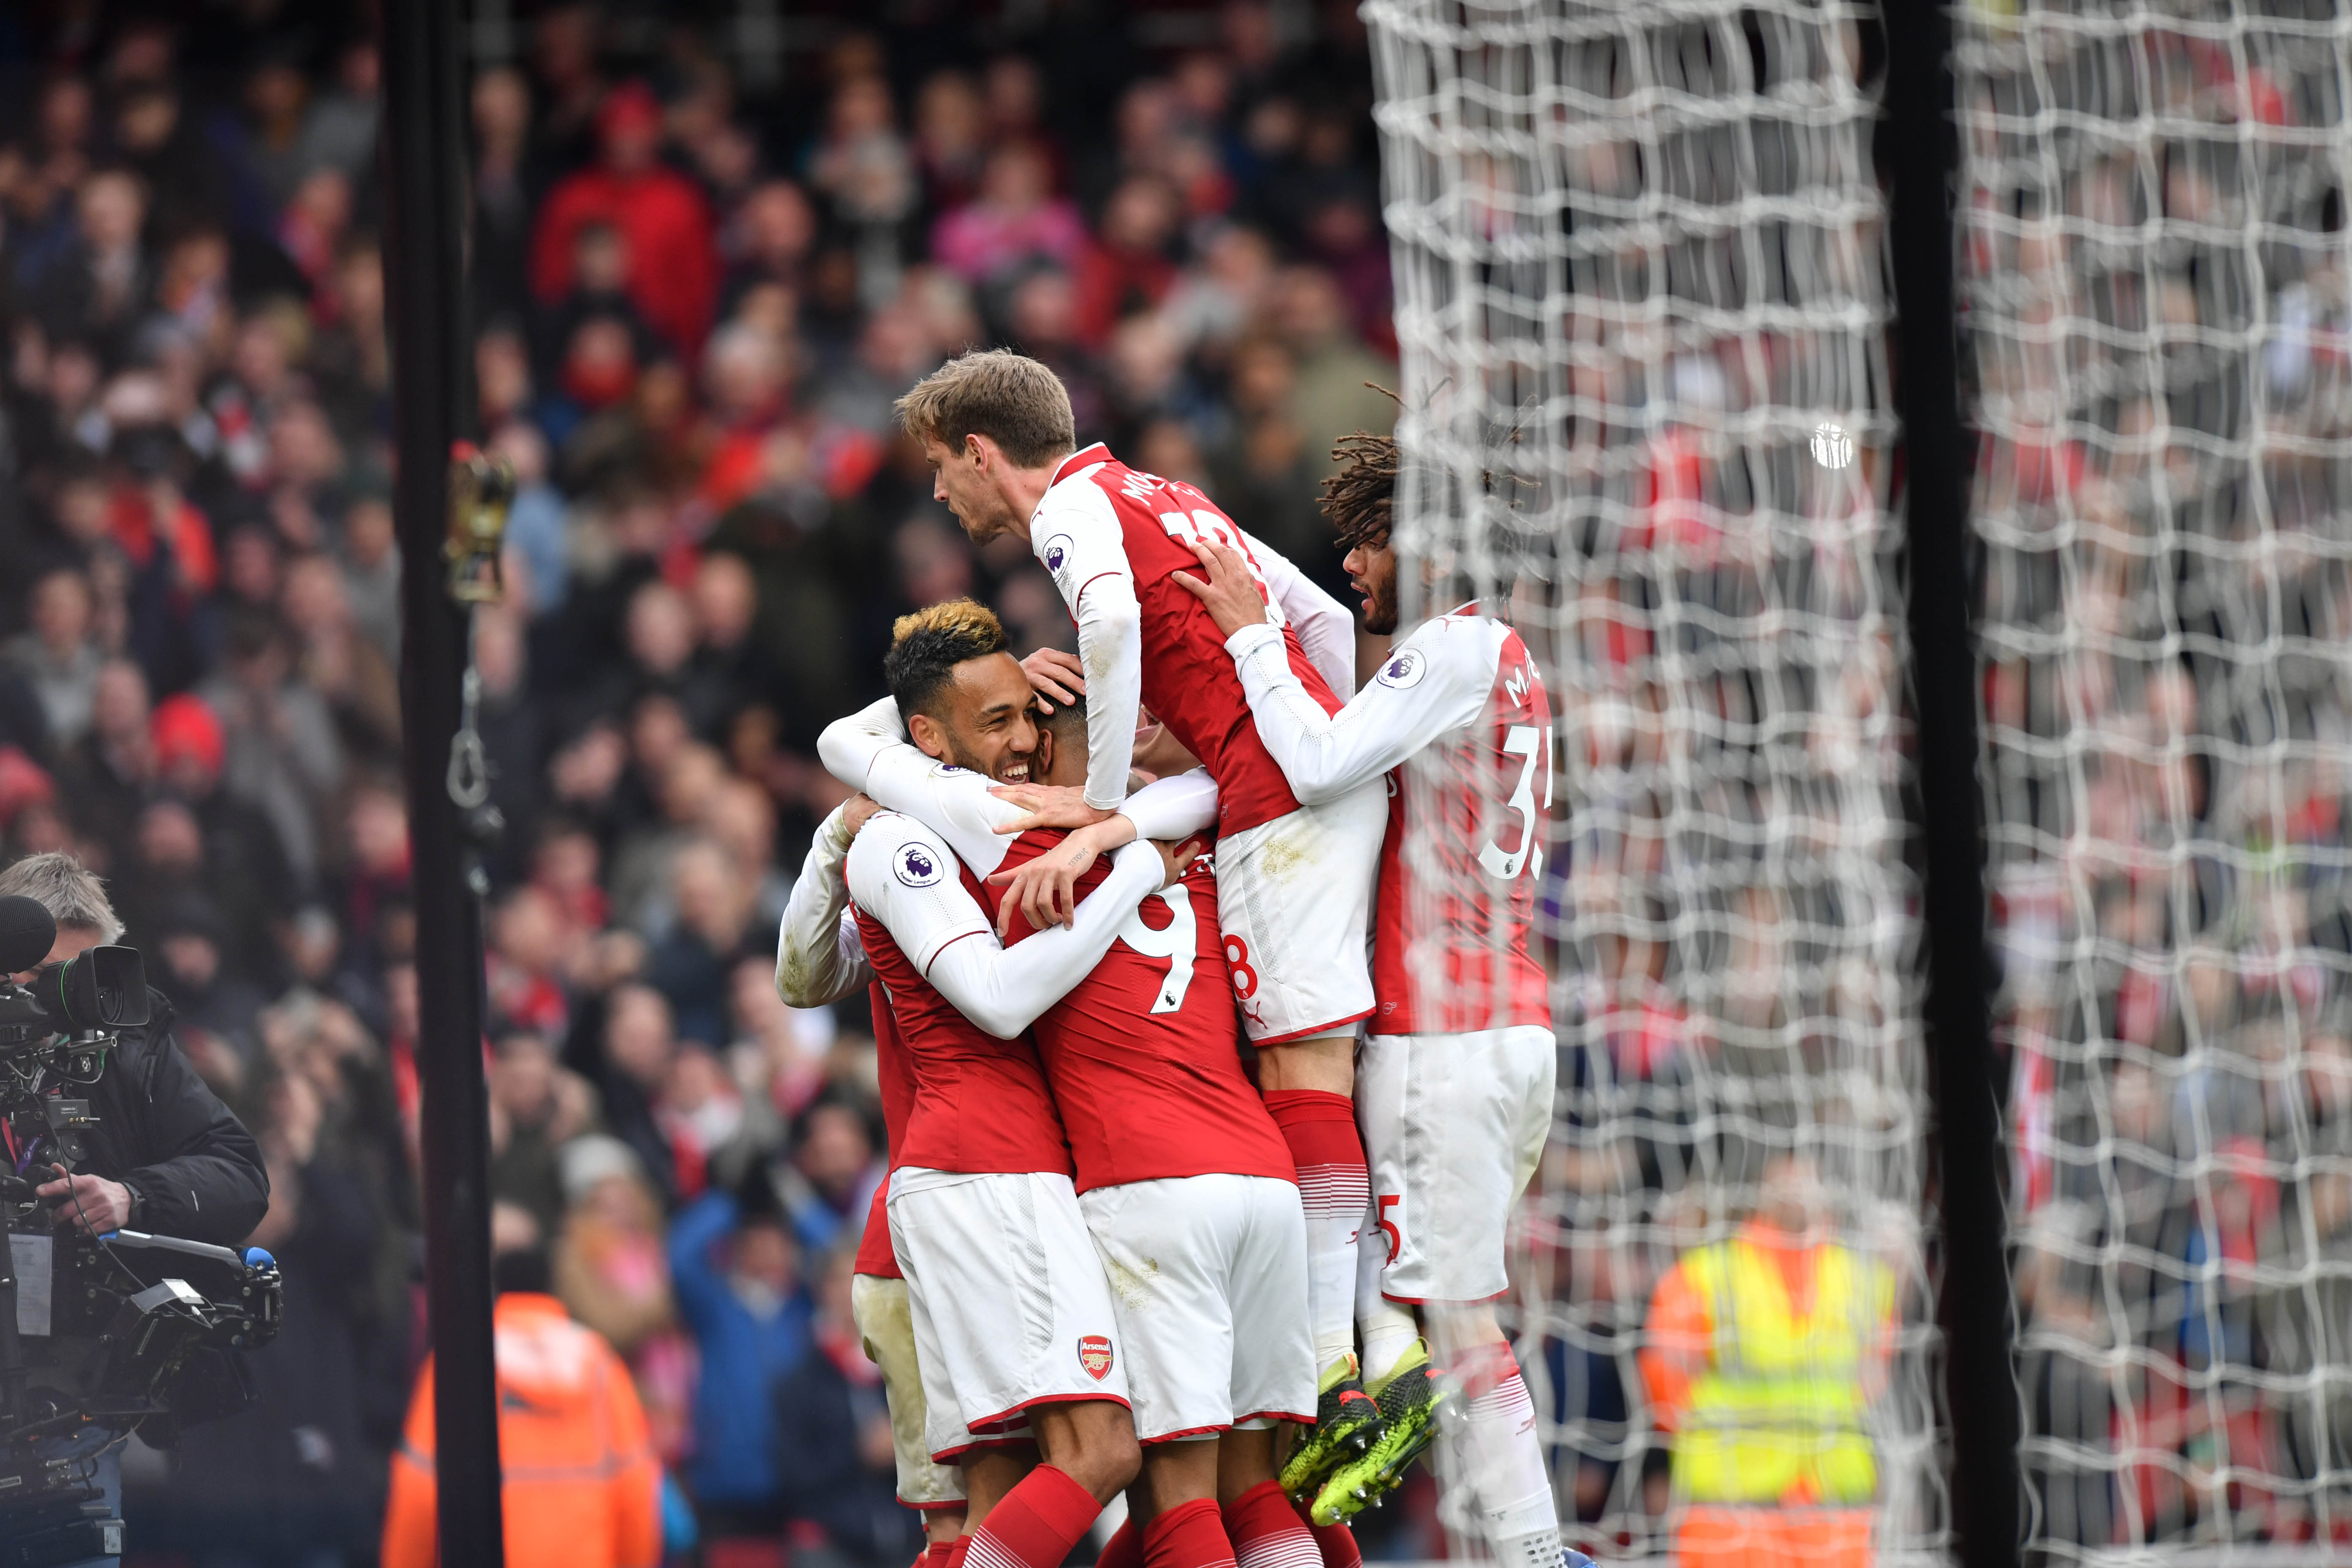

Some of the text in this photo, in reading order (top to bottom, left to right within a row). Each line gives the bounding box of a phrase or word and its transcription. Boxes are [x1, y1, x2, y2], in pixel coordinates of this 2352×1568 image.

[1119, 883, 1197, 1015] 9
[1223, 934, 1258, 1000] 8
[1378, 1194, 1400, 1260] 5
[1082, 1342, 1109, 1351] Arsenal
